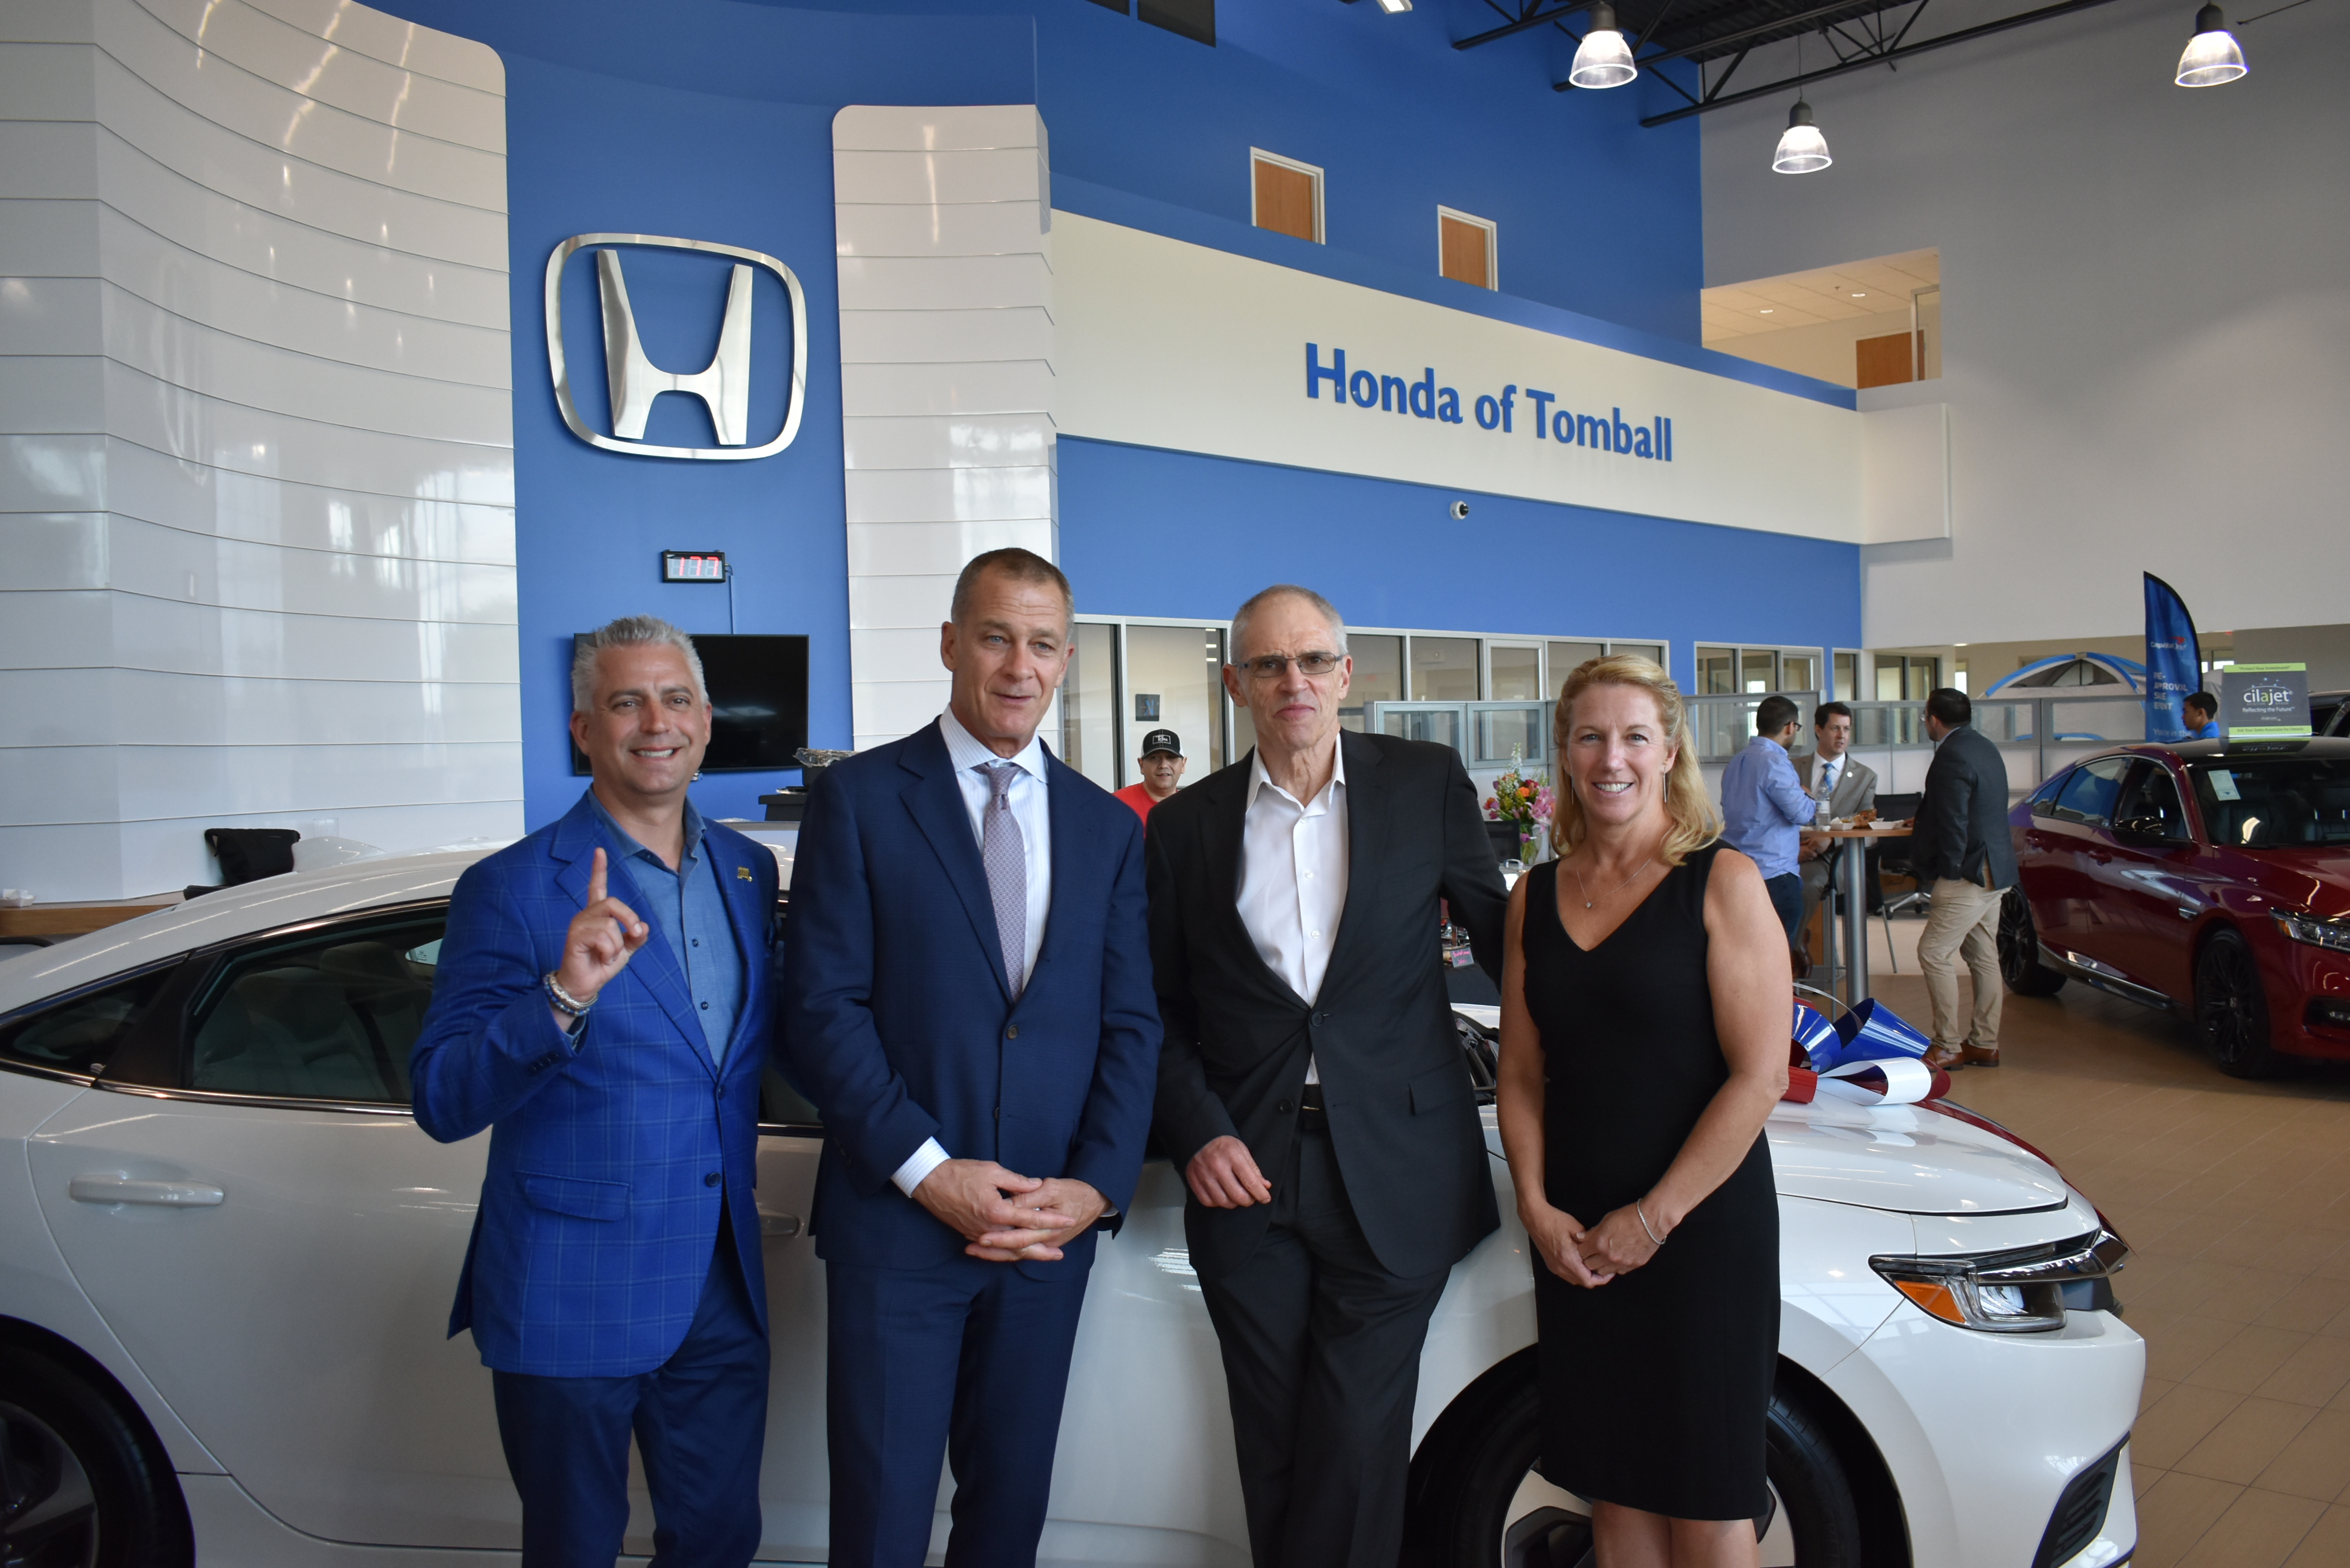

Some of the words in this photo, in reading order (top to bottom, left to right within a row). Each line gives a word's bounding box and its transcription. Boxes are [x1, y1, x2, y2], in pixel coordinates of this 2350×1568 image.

[1306, 342, 1463, 424] Honda
[1475, 384, 1517, 433] of
[1526, 388, 1673, 463] Tomball
[679, 556, 719, 576] 177
[2243, 688, 2289, 706] cilajet
